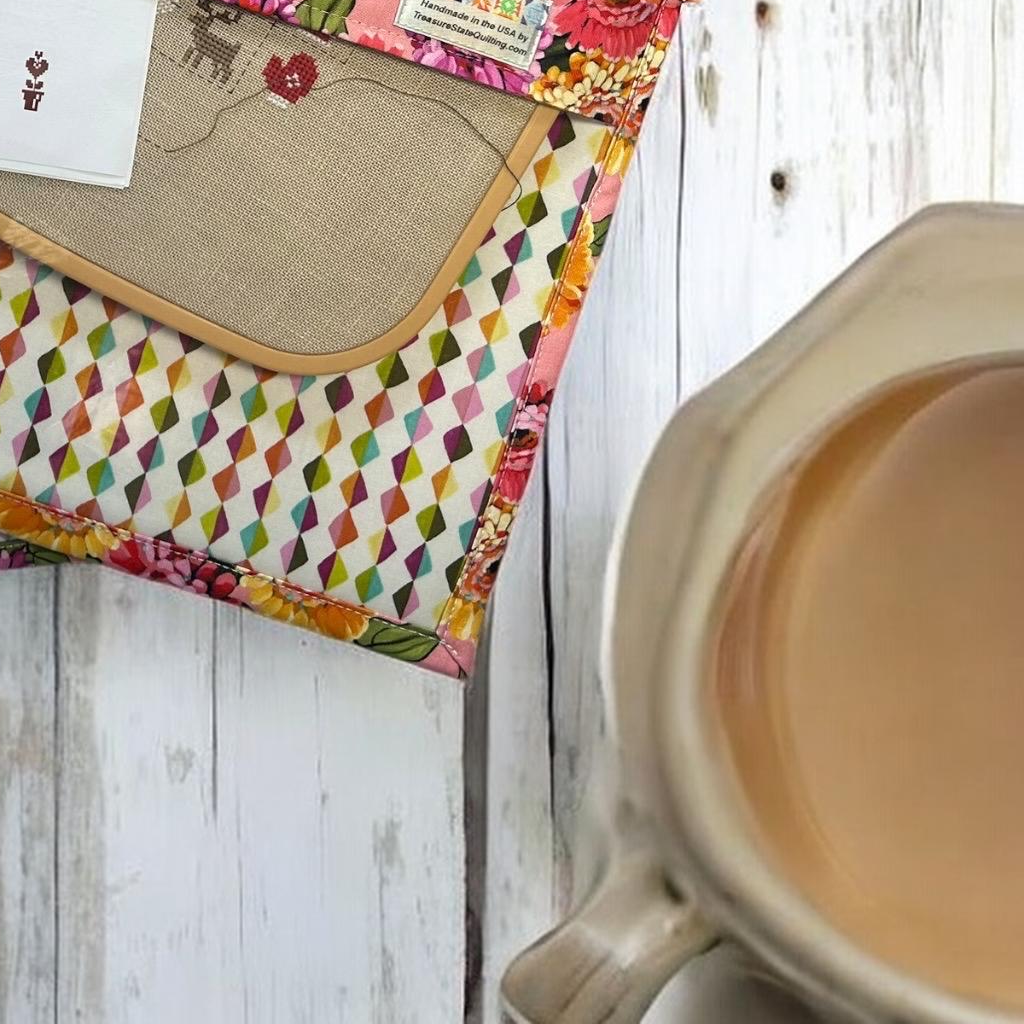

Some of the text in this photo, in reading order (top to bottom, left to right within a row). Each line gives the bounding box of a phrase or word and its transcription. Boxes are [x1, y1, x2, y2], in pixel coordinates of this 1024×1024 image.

[413, 10, 527, 56] TreasureStateQuilting.com
[470, 15, 480, 25] in
[481, 18, 496, 30] the
[497, 25, 516, 38] USA
[517, 31, 529, 43] by
